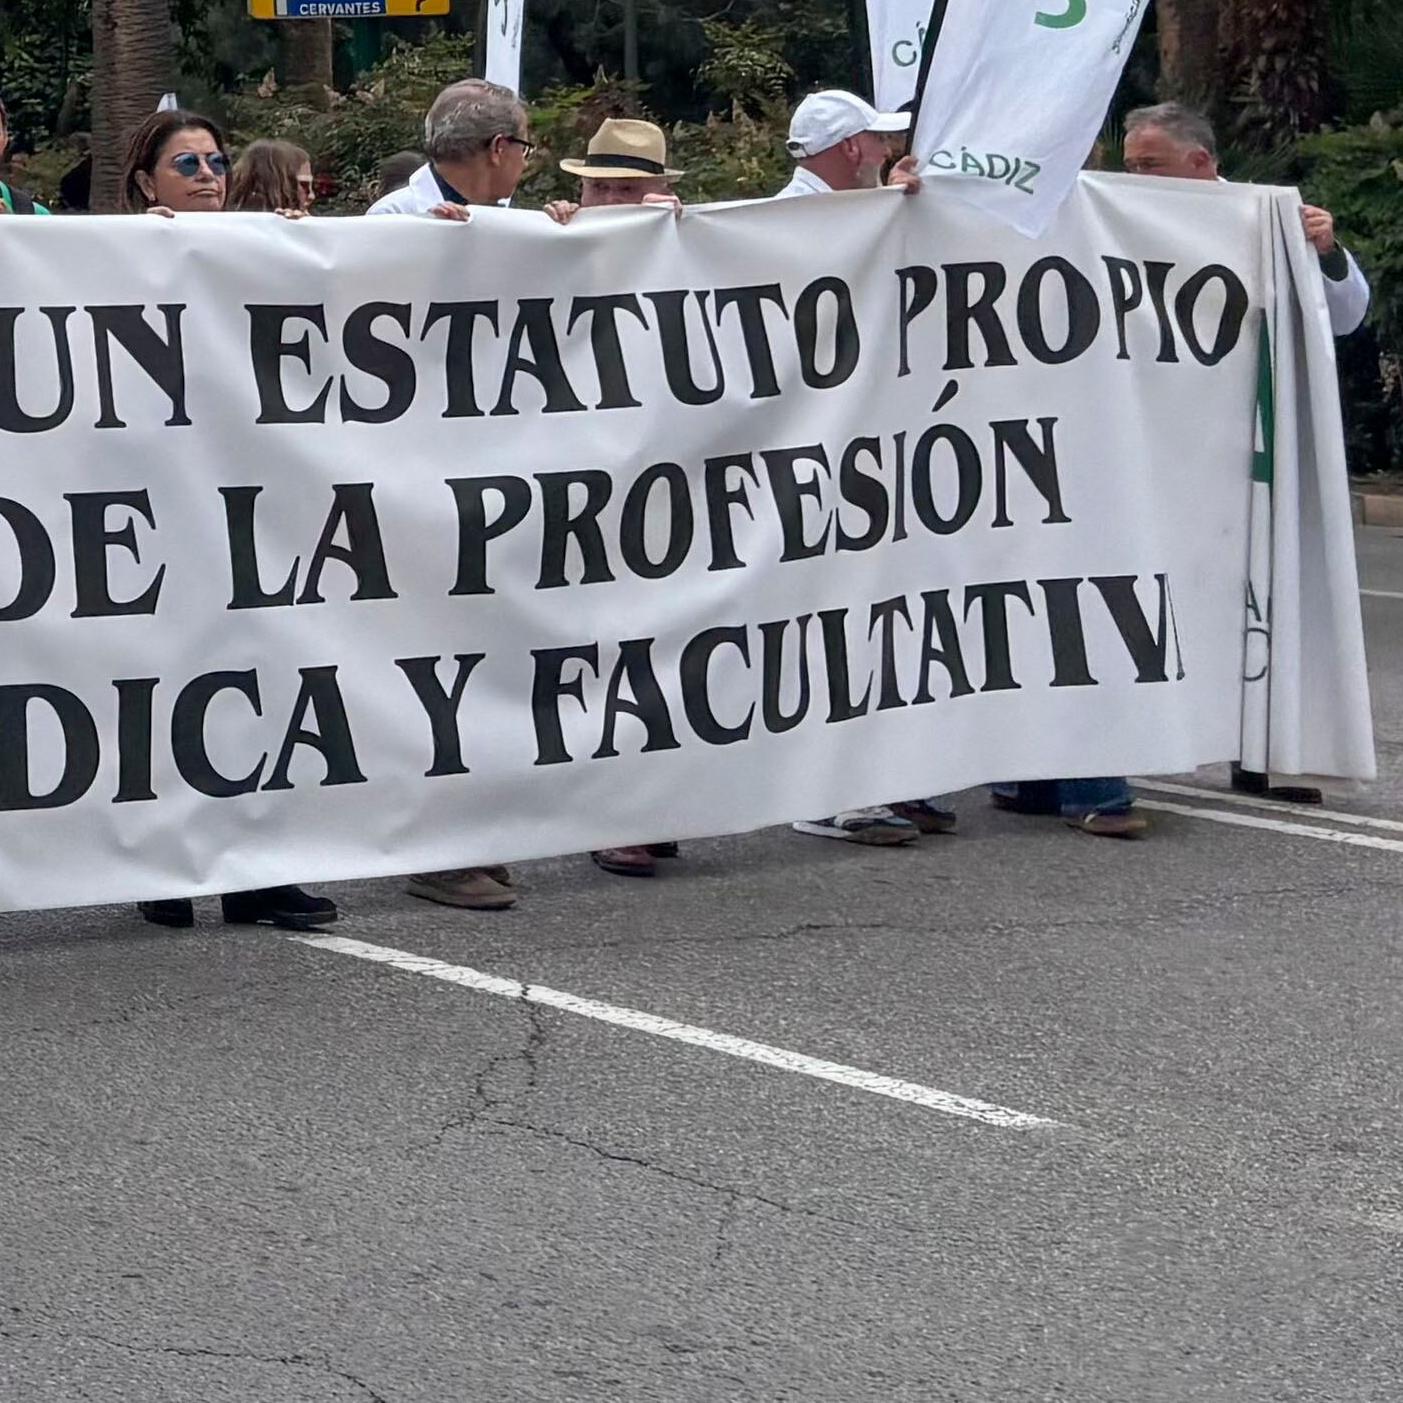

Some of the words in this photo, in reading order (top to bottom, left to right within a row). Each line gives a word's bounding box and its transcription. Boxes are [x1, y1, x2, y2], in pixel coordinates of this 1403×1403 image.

[299, 1, 381, 16] CERVANTES
[929, 146, 1041, 195] CÁDIZ
[245, 276, 860, 426] ESTATUTO
[896, 255, 1249, 378] PROPIO
[218, 482, 399, 610] LA
[446, 379, 1072, 595] PROFESIÓN
[394, 653, 487, 778] Y
[530, 572, 1185, 766] FACULTATIV
